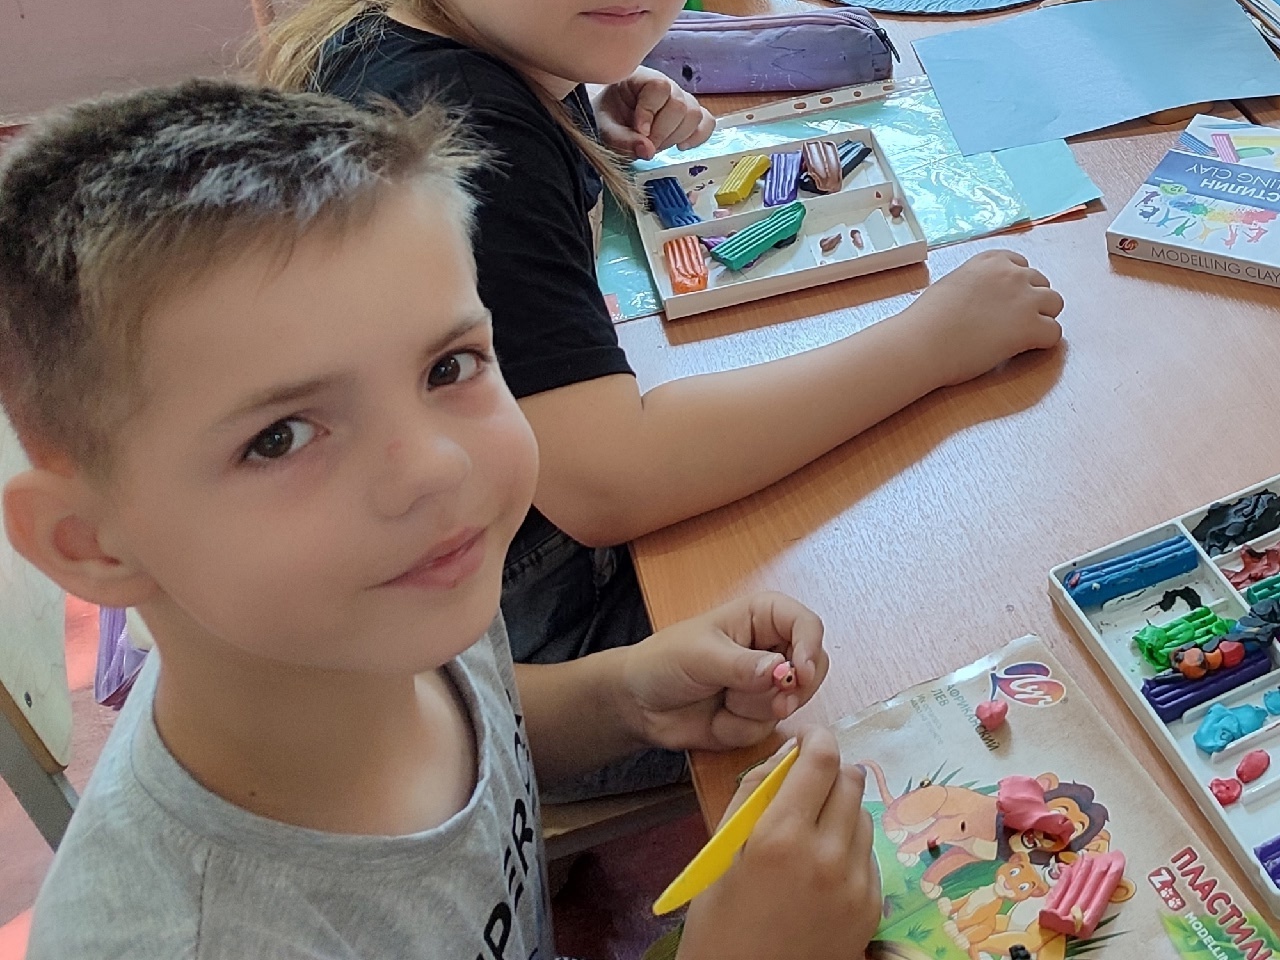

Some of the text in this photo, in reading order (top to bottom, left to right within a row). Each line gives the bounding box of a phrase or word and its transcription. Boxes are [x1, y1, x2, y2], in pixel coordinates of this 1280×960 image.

[1186, 162, 1234, 183] CLAY
[1150, 245, 1241, 275] MODELLING
[1245, 266, 1280, 284] CLAY
[931, 688, 950, 708] ЛЕВ
